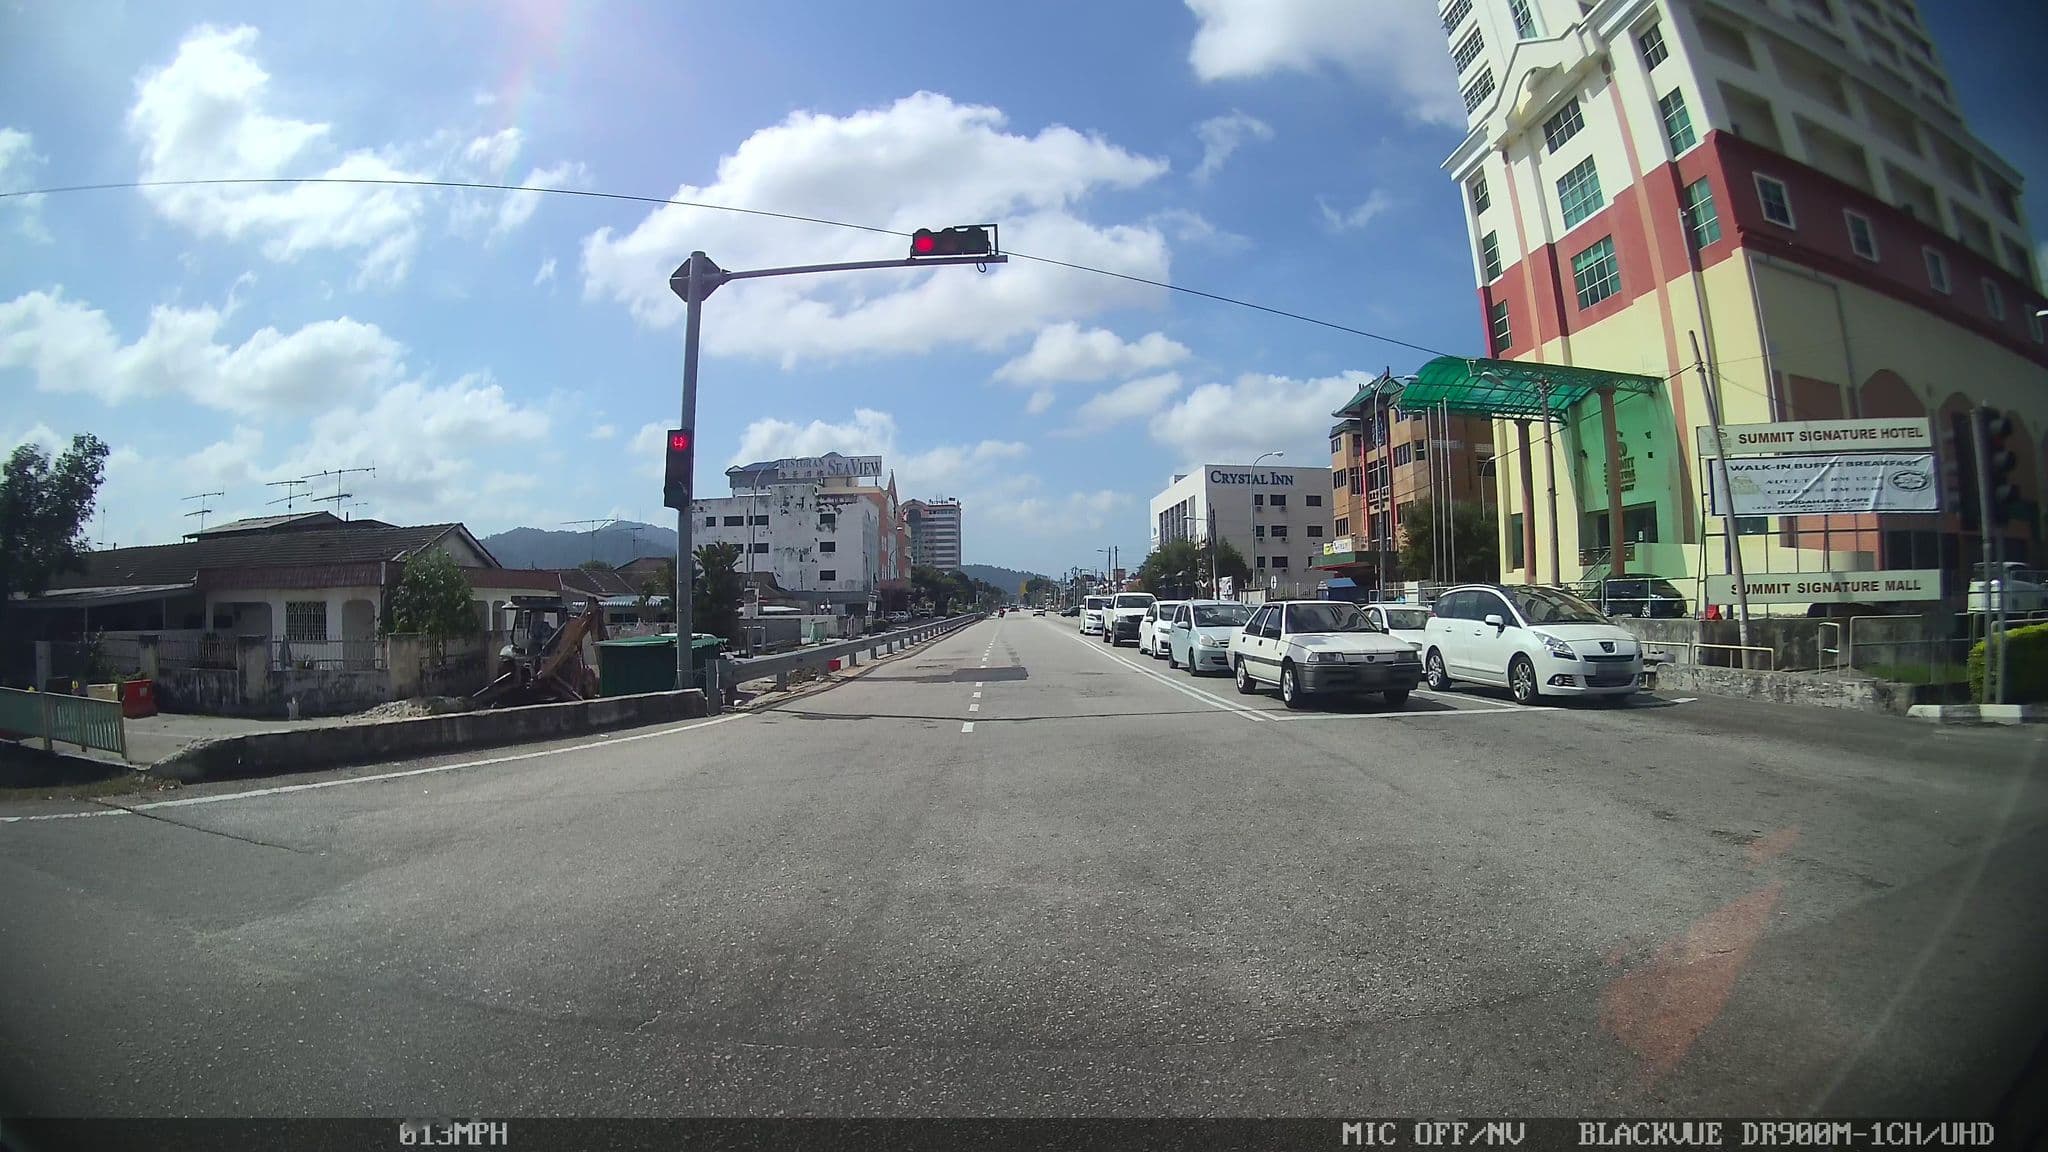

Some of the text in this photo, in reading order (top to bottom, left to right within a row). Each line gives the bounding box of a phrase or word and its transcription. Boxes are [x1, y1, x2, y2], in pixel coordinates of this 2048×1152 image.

[1738, 432, 1795, 444] SUMMIT
[1798, 428, 1877, 442] SIGNATURE
[1880, 427, 1924, 439] HOTEL
[1729, 463, 1791, 471] WALK-IN
[1794, 461, 1844, 469] BUFFET
[1210, 470, 1294, 485] CRYSTAL INN
[1731, 579, 1921, 595] SUMMIT SIGNATURE MALL
